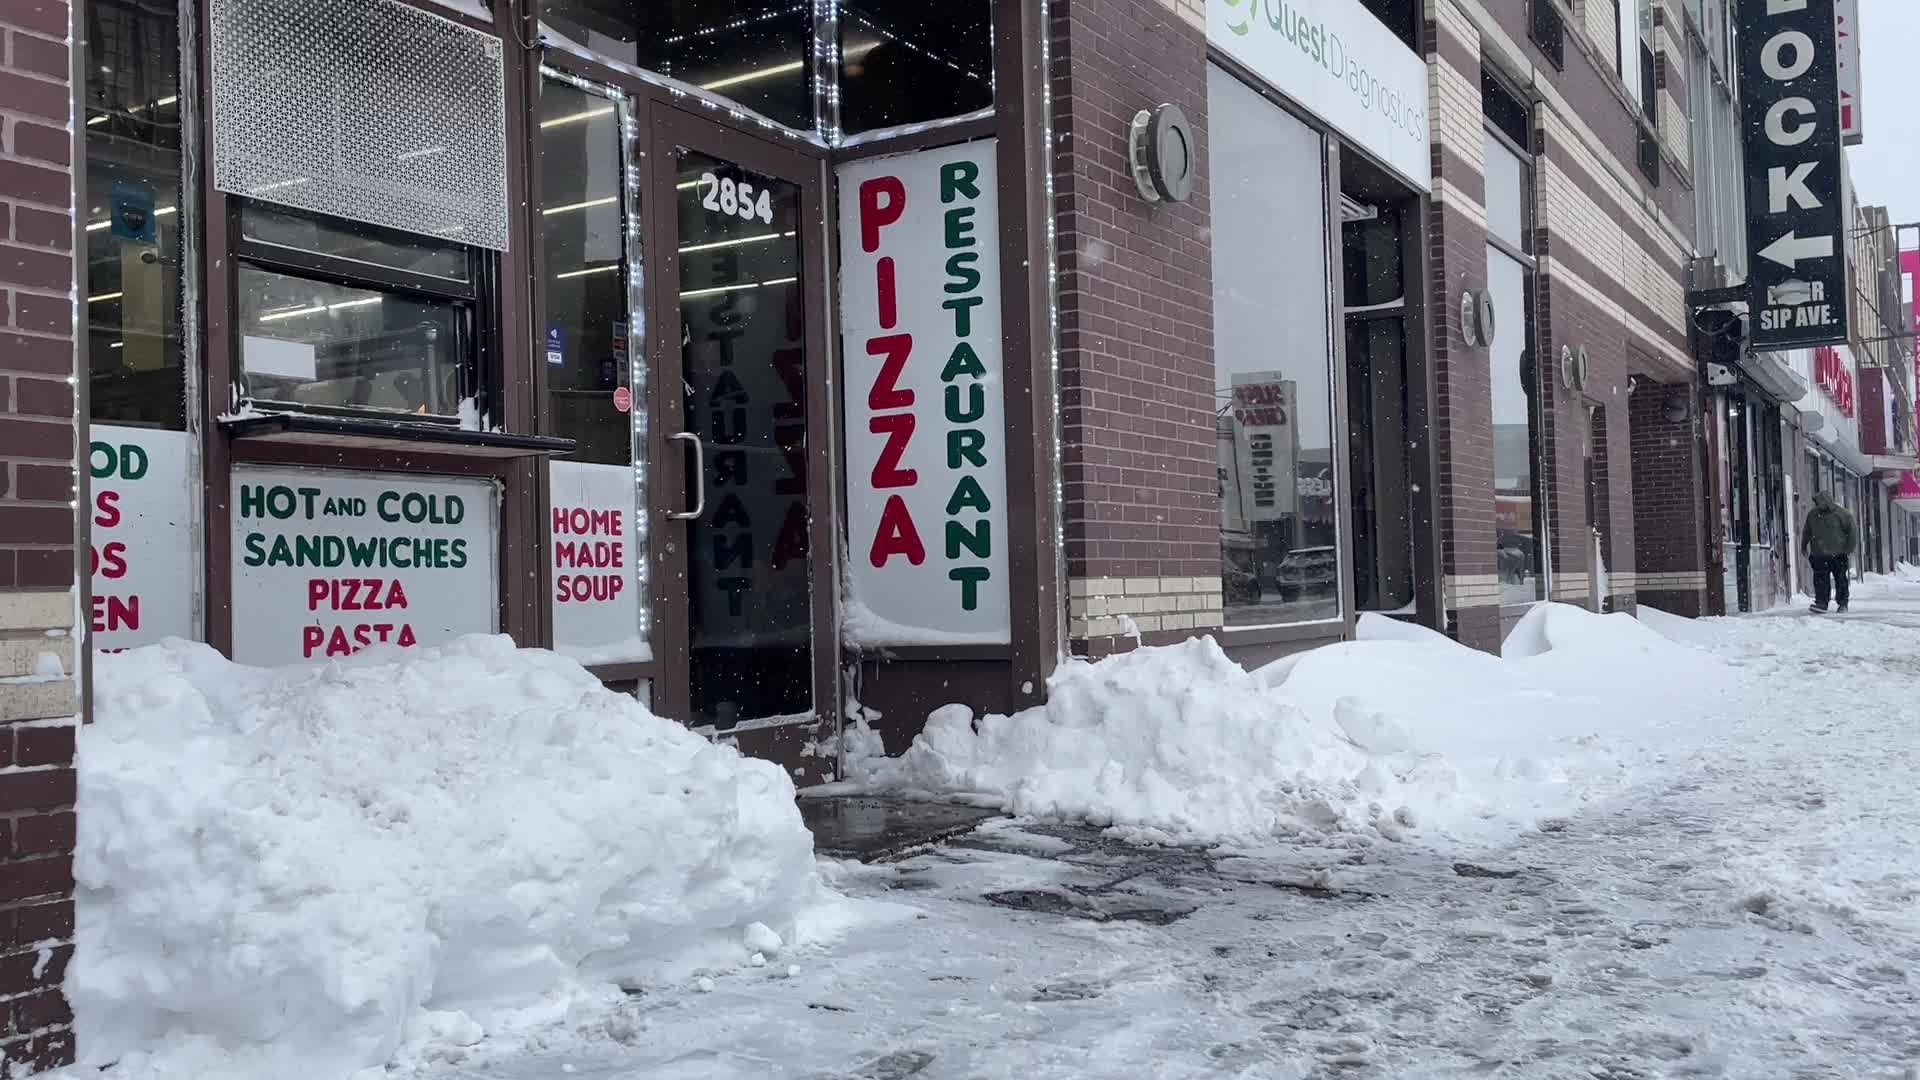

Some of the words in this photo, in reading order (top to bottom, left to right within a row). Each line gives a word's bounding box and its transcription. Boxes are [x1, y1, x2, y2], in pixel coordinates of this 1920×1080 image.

[1760, 0, 1824, 213] OCK
[701, 173, 774, 225] 2854
[1760, 309, 1792, 330] SIP
[859, 175, 925, 568] PIZZA
[940, 160, 991, 611] RESTAURANT
[240, 485, 321, 520] HOT
[323, 498, 366, 516] AND
[377, 491, 464, 524] COLD
[553, 507, 622, 536] HOME
[244, 533, 467, 568] SANDWICHES
[556, 541, 623, 568] MADE
[308, 579, 408, 611] PIZZA
[557, 574, 623, 602] SOUP
[303, 624, 416, 658] PASTA
